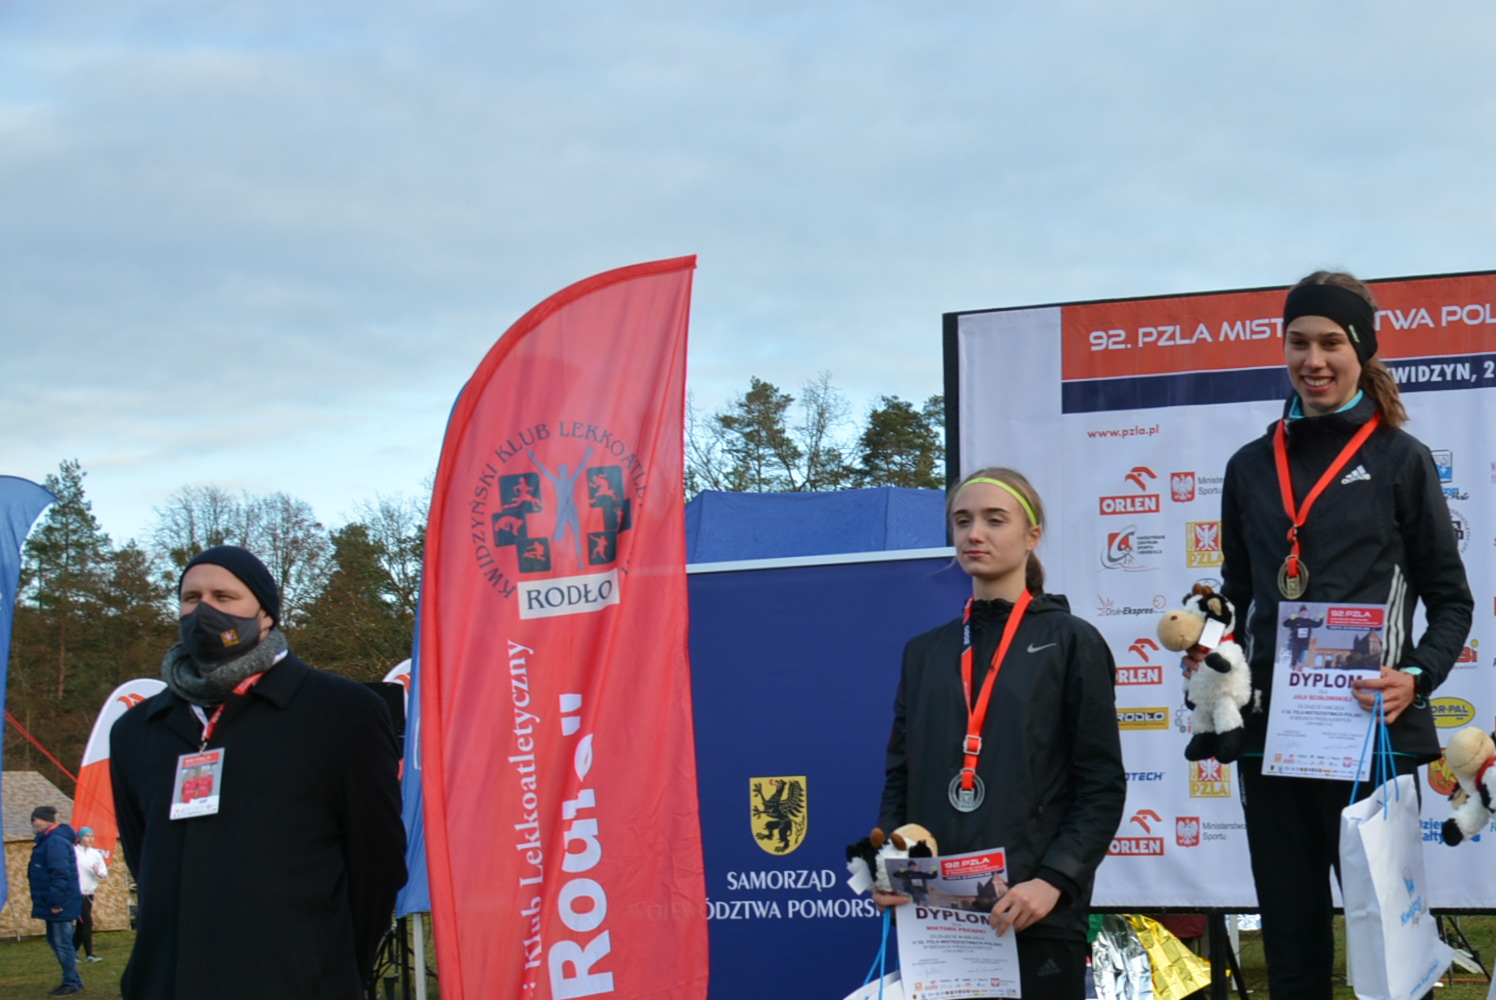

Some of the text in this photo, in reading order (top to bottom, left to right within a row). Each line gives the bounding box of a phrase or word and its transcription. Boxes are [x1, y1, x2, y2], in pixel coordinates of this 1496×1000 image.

[1089, 330, 1131, 351] 92.
[1138, 322, 1213, 347] PZLA
[1087, 424, 1160, 438] www.pzla.pl
[471, 423, 551, 599] KWIDZYŃSKI KLUB
[1102, 497, 1158, 512] ORLEN
[525, 579, 613, 610] RODŁO
[507, 639, 544, 888] Lekkoatletyczny
[1191, 782, 1227, 795] PZLA
[1203, 832, 1227, 842] Sportu
[1109, 840, 1162, 854] ORLEN
[727, 870, 836, 892] SAMORZĄD
